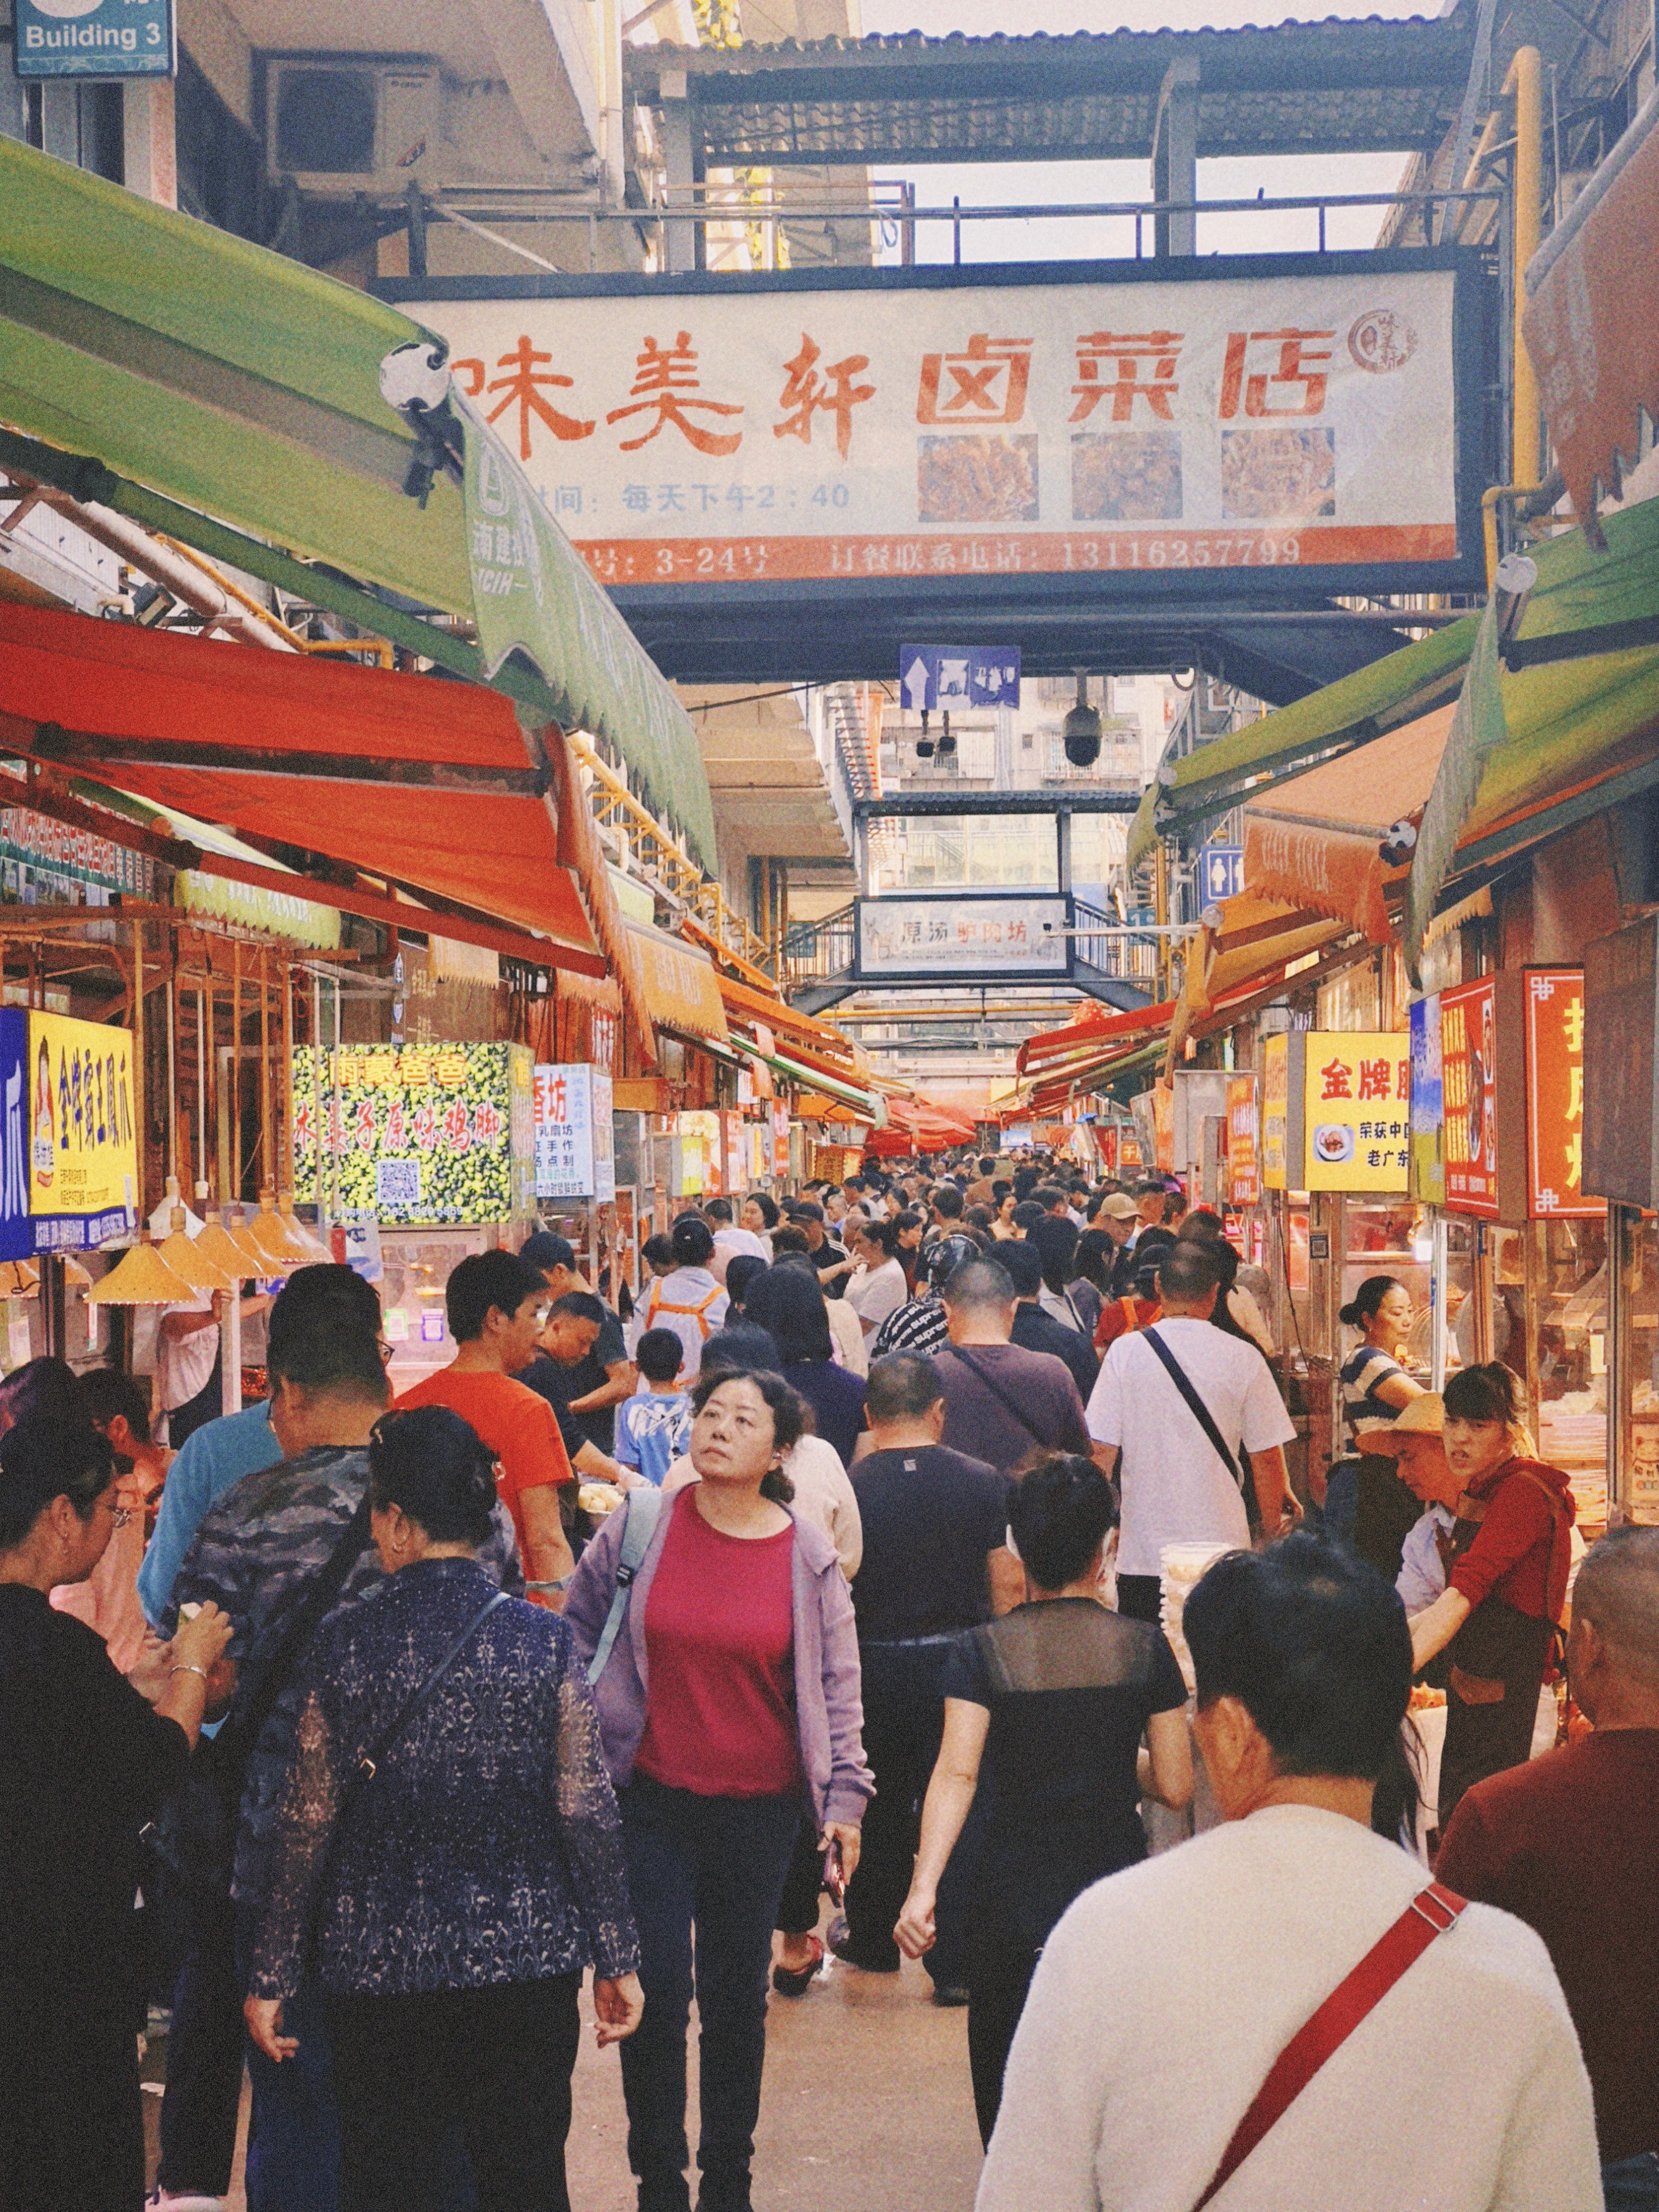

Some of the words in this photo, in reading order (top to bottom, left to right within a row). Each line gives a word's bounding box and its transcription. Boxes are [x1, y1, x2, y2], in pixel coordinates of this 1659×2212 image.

[27, 24, 137, 51] Building
[146, 23, 161, 44] 3
[541, 483, 849, 515] 间：每天下午2：40
[581, 545, 769, 576] 号：3-24号
[293, 1099, 502, 1154] 木姜子原味鸡脚
